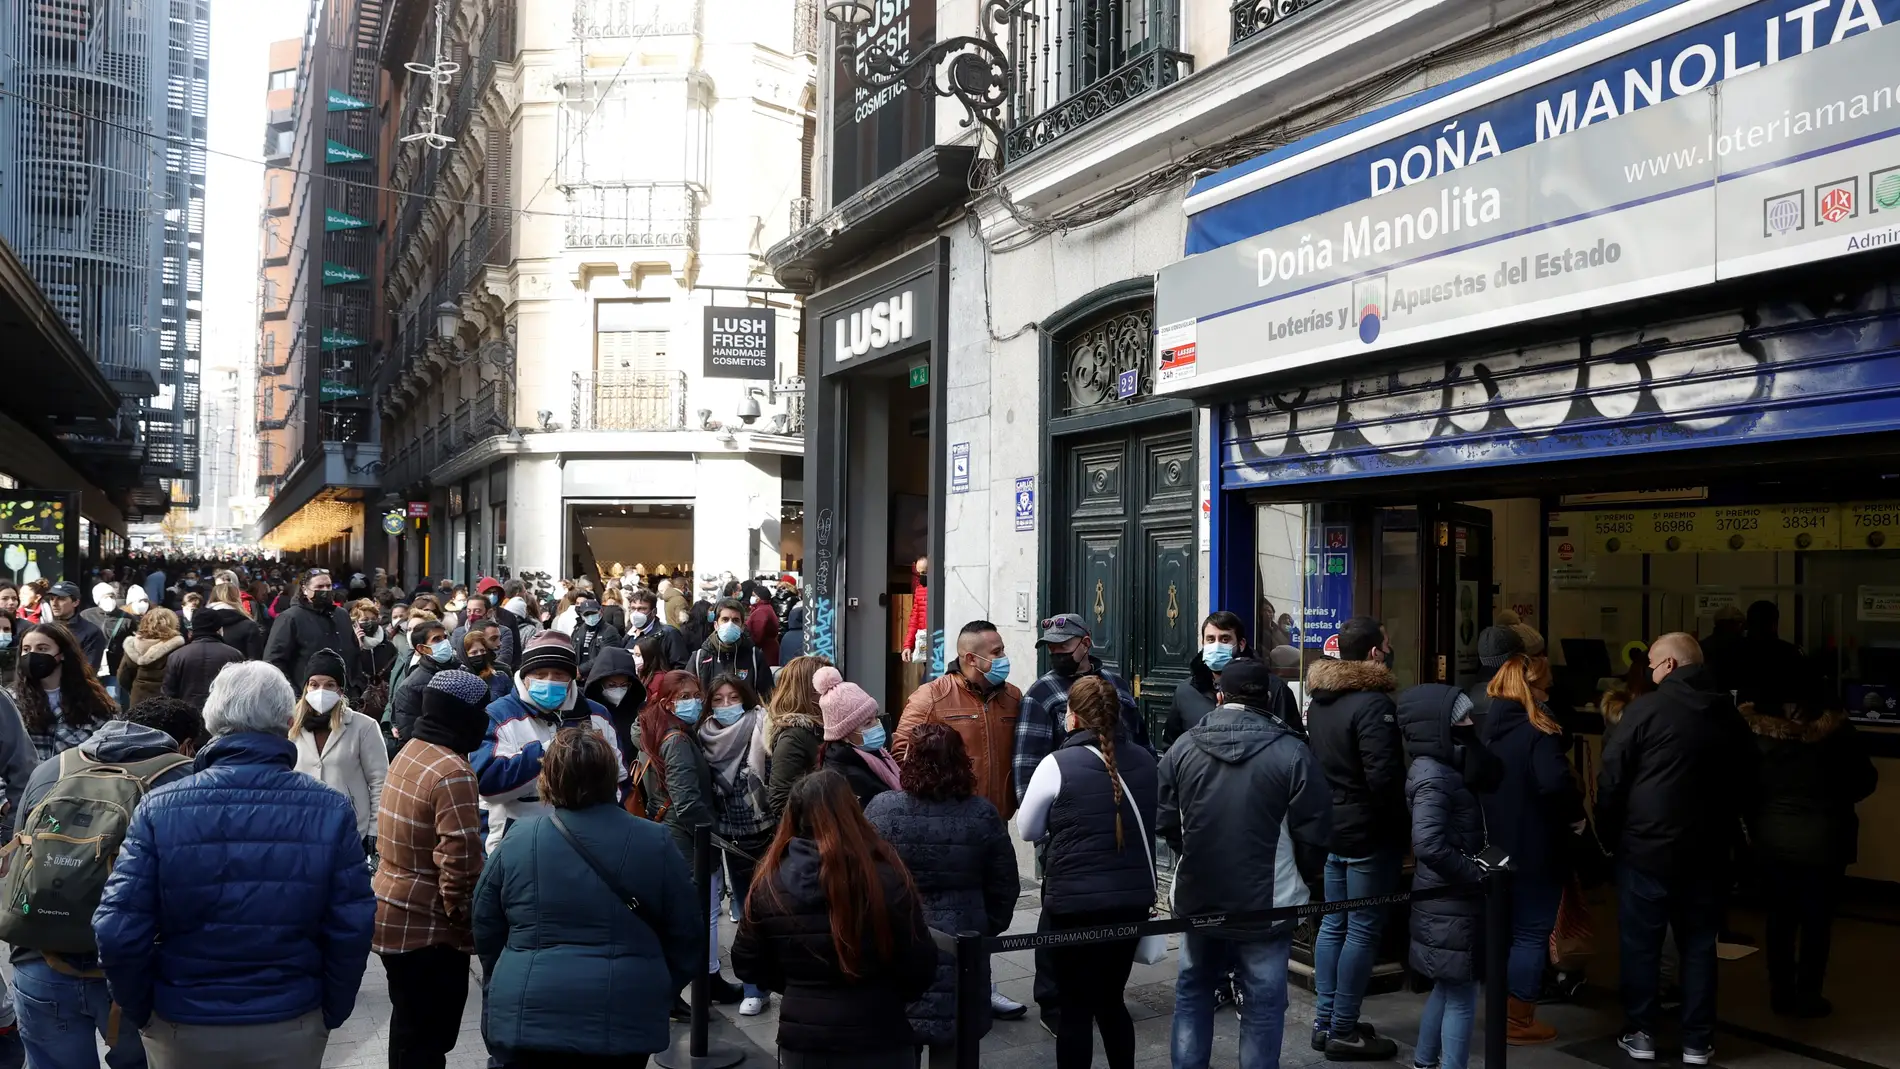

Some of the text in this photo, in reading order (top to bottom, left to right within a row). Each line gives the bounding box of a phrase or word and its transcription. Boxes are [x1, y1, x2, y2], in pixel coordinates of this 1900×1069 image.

[1370, 0, 1884, 198] DOÑA MANOLITA
[1257, 186, 1500, 288] Doña Manolita
[1268, 238, 1622, 342] Loterías y Apuestas del Estado
[712, 318, 766, 334] LUSH
[836, 290, 913, 362] LUSH
[712, 334, 766, 348] FRESH
[712, 348, 766, 358] HANDMADE
[712, 357, 766, 366] COSMETICS
[1122, 376, 1134, 392] 22
[1726, 508, 1760, 516] PREMIO
[1654, 520, 1694, 533] 86986
[1716, 518, 1758, 530] 37023
[1782, 515, 1826, 529] 38341
[1854, 513, 1900, 527] 75981
[1596, 522, 1633, 534] 55483
[1331, 608, 1336, 617] y
[1293, 620, 1332, 630] Auestas
[1296, 892, 1411, 914] WWW.LOTERIAMANOLITA.COM
[1002, 926, 1138, 948] WWW.LOTERIAMANOLITA.COM
